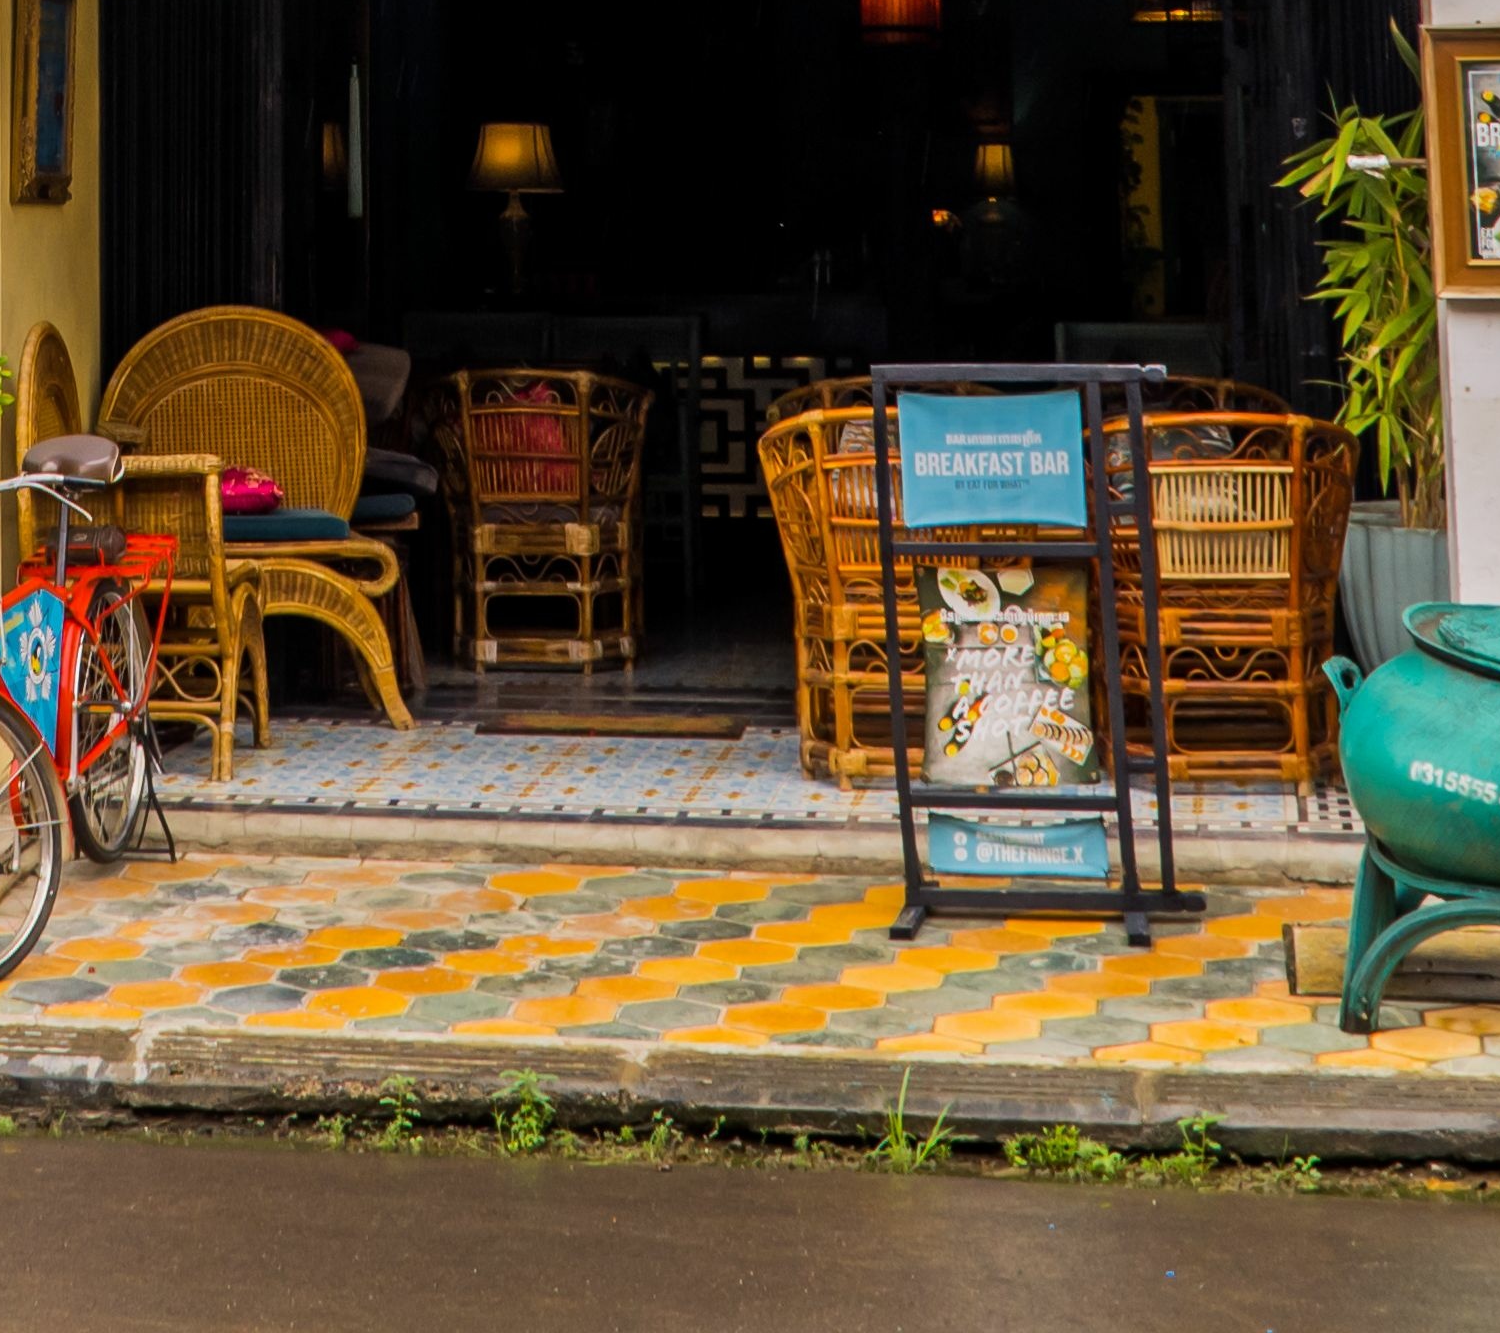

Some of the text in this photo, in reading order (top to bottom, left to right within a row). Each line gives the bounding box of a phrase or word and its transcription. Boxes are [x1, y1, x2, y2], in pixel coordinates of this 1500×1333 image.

[914, 450, 1070, 477] BREAKFAST BAR
[956, 645, 1037, 671] MORE
[950, 671, 1027, 696] THAN
[952, 687, 1076, 720] A COFFEE
